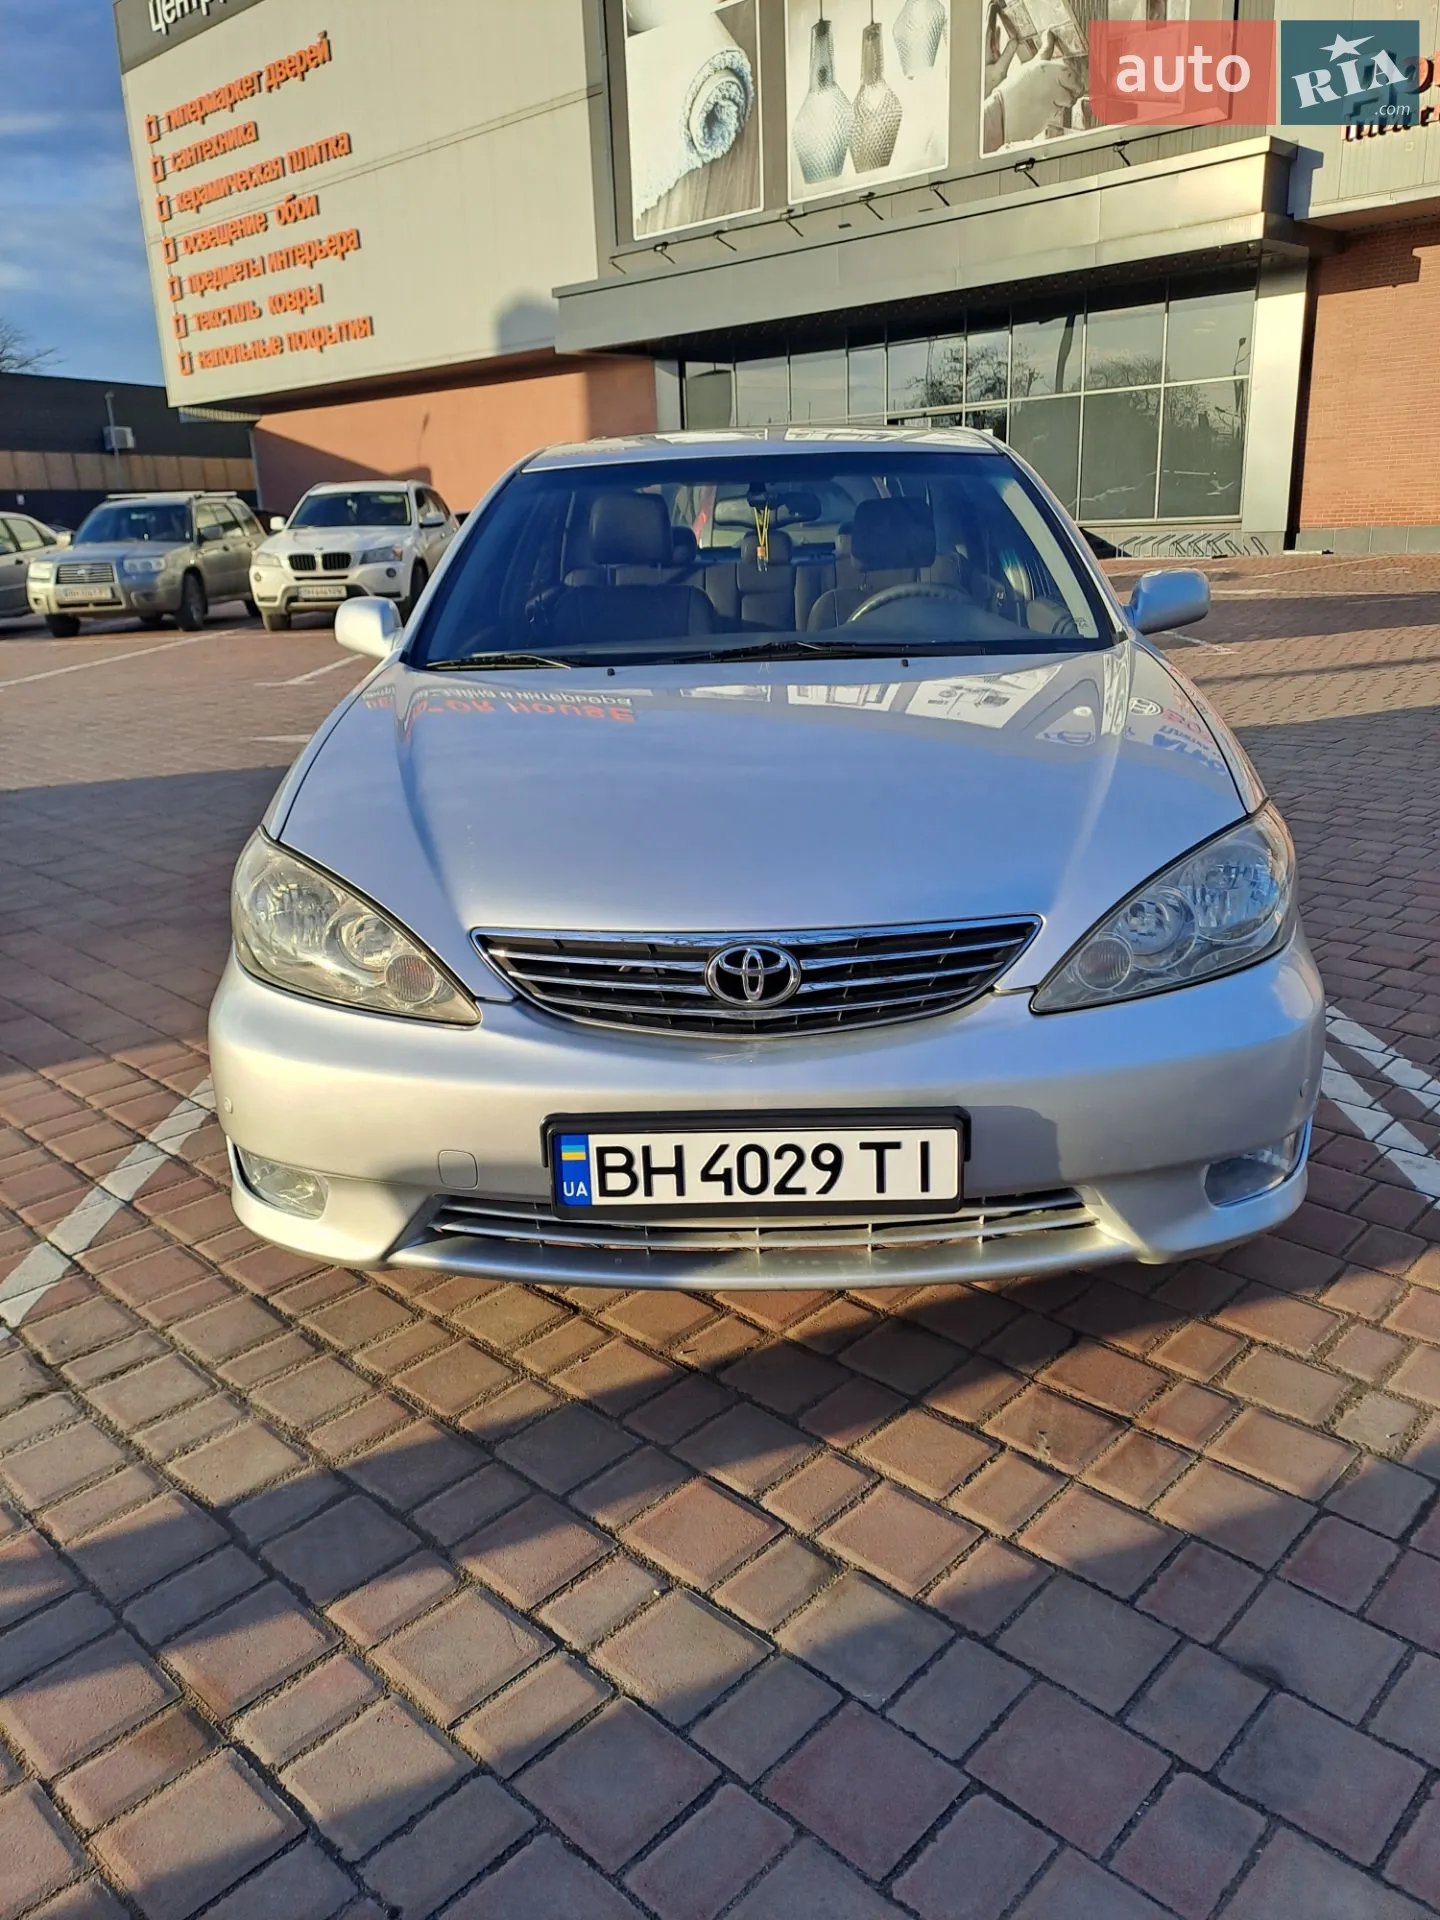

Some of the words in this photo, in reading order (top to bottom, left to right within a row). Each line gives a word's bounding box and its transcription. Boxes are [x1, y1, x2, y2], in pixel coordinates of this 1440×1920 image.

[164, 70, 262, 133] гипермаркет
[264, 30, 332, 92] дверей
[169, 120, 258, 172] сантехника
[175, 156, 285, 213] керамическая
[286, 132, 352, 174] плитка
[182, 210, 268, 255] освещение
[274, 193, 320, 226] обои
[187, 255, 266, 297] предметы
[267, 227, 361, 269] интерьера
[192, 299, 262, 332] текстиль
[268, 282, 324, 315] ковры
[197, 335, 284, 369] напольные
[285, 316, 375, 353] покрытия
[562, 1181, 588, 1197] UA
[595, 1144, 686, 1198] BH
[700, 1143, 844, 1196] 4029
[859, 1140, 931, 1194] TI
